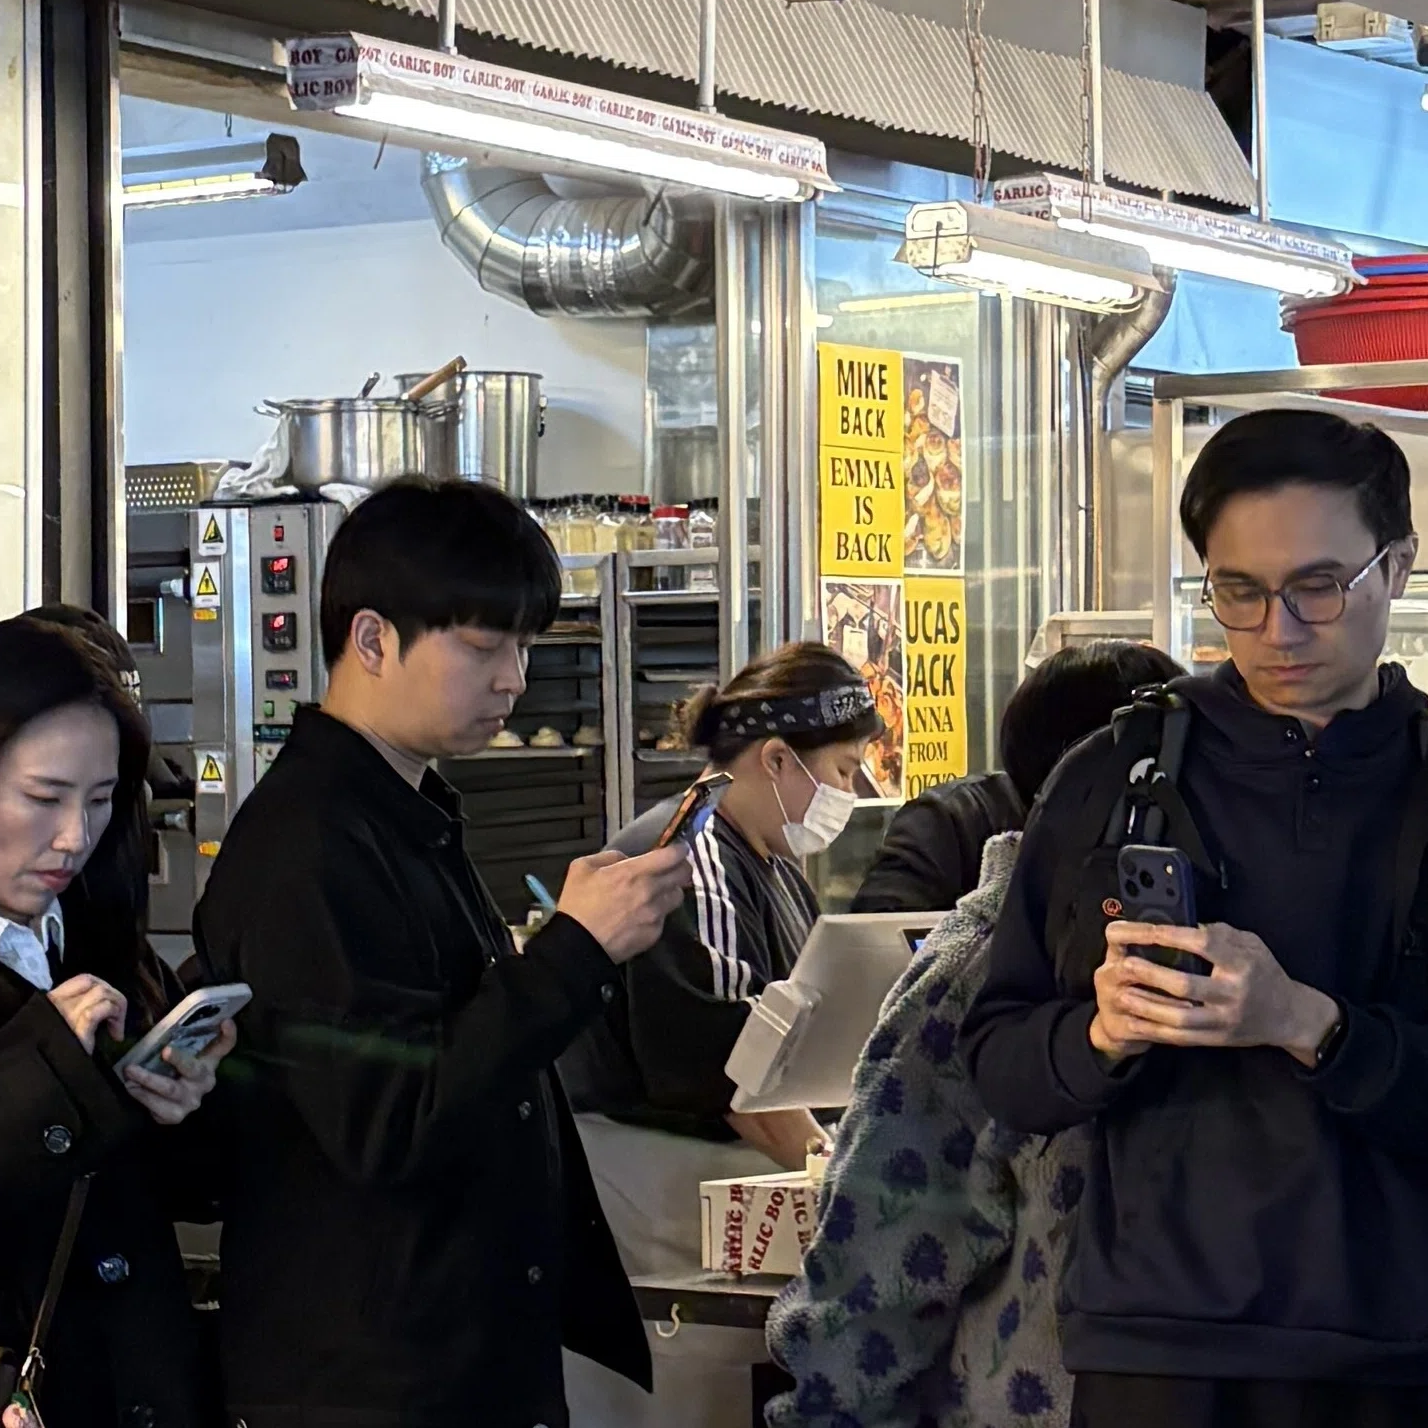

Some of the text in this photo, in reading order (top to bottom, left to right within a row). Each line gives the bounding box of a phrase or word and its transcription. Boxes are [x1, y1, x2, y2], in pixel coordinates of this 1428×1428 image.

[290, 47, 322, 66] BOY
[389, 51, 431, 73] GARLIC
[463, 68, 503, 90] GARLIC
[324, 78, 355, 95] BOY
[994, 185, 1044, 201] GARLIC
[837, 358, 889, 401] MIKE
[840, 405, 886, 438] BACK
[830, 456, 895, 489] EMMA
[854, 495, 874, 525] IS
[836, 531, 892, 562] BACK
[909, 741, 948, 762] FROM
